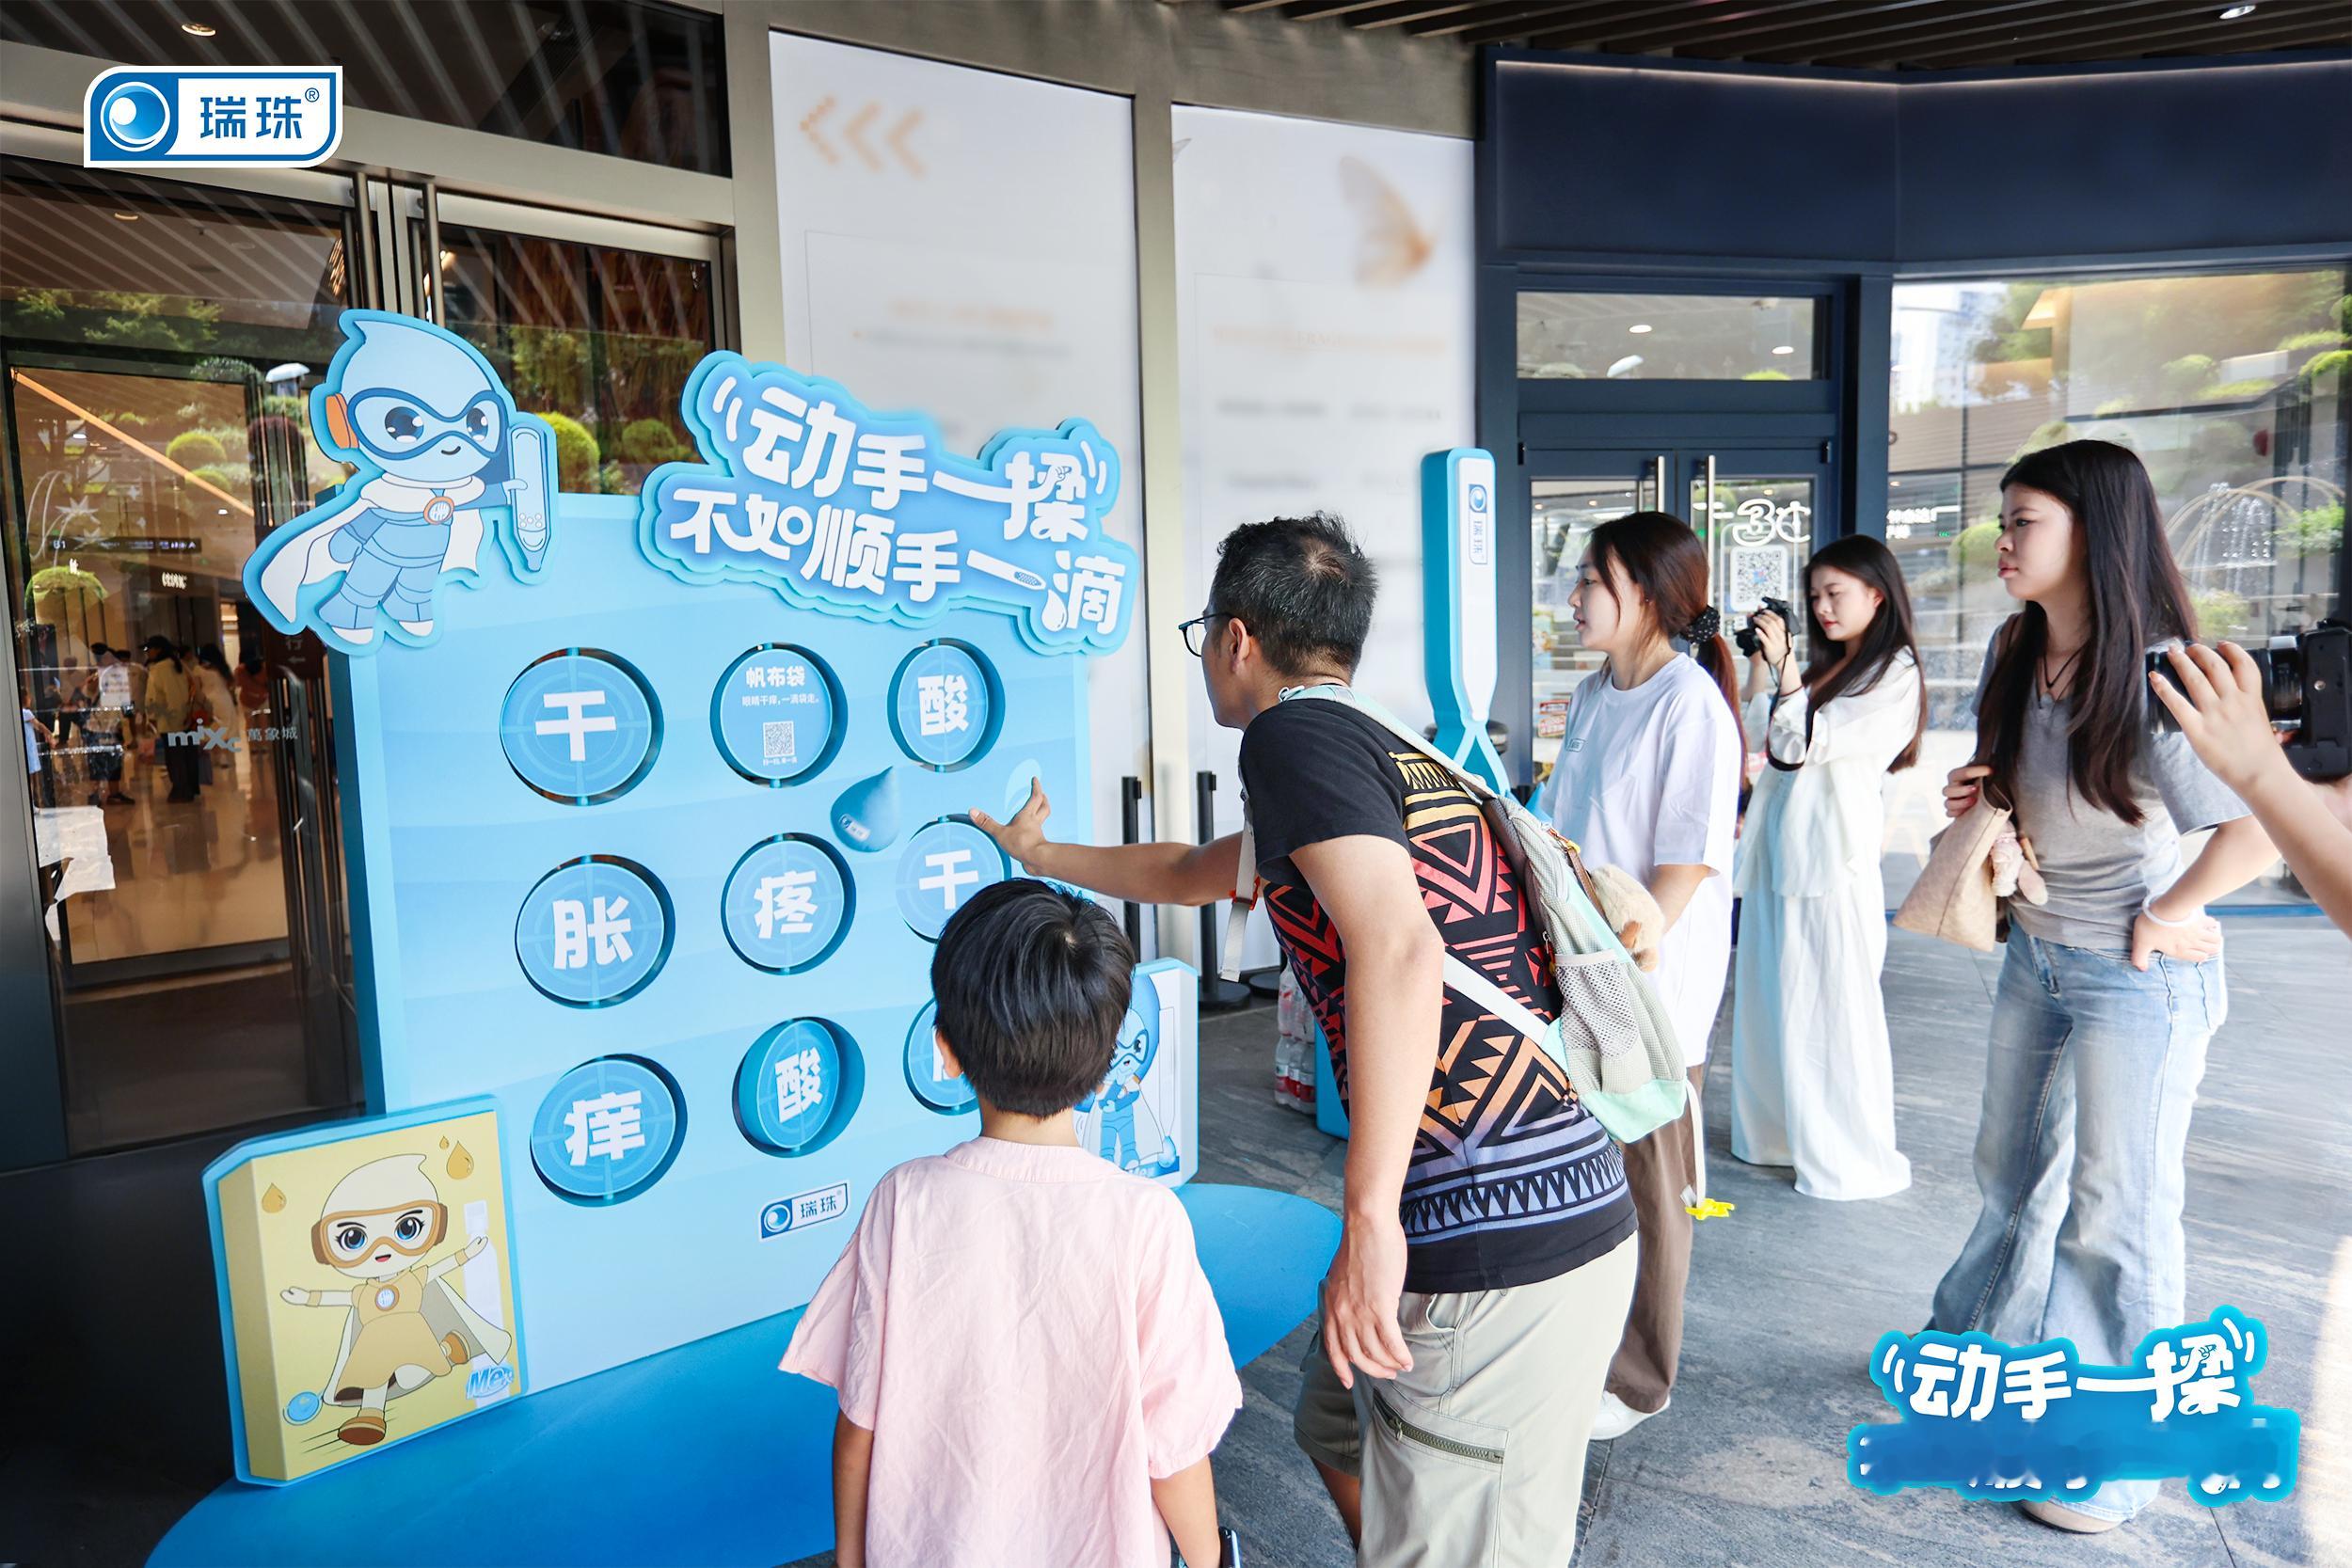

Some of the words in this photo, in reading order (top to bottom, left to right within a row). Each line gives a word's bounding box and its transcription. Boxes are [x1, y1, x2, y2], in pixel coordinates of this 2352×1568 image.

[741, 386, 1089, 542] 动手一揉
[670, 488, 1127, 635] 不如顺手一滴
[746, 666, 805, 688] 帆布袋
[917, 674, 970, 737] 酸
[535, 689, 617, 762] 干
[754, 870, 818, 940] 疼
[918, 849, 979, 911] 干
[552, 895, 634, 971] 胀
[774, 1047, 823, 1123] 酸
[564, 1090, 646, 1166] 痒
